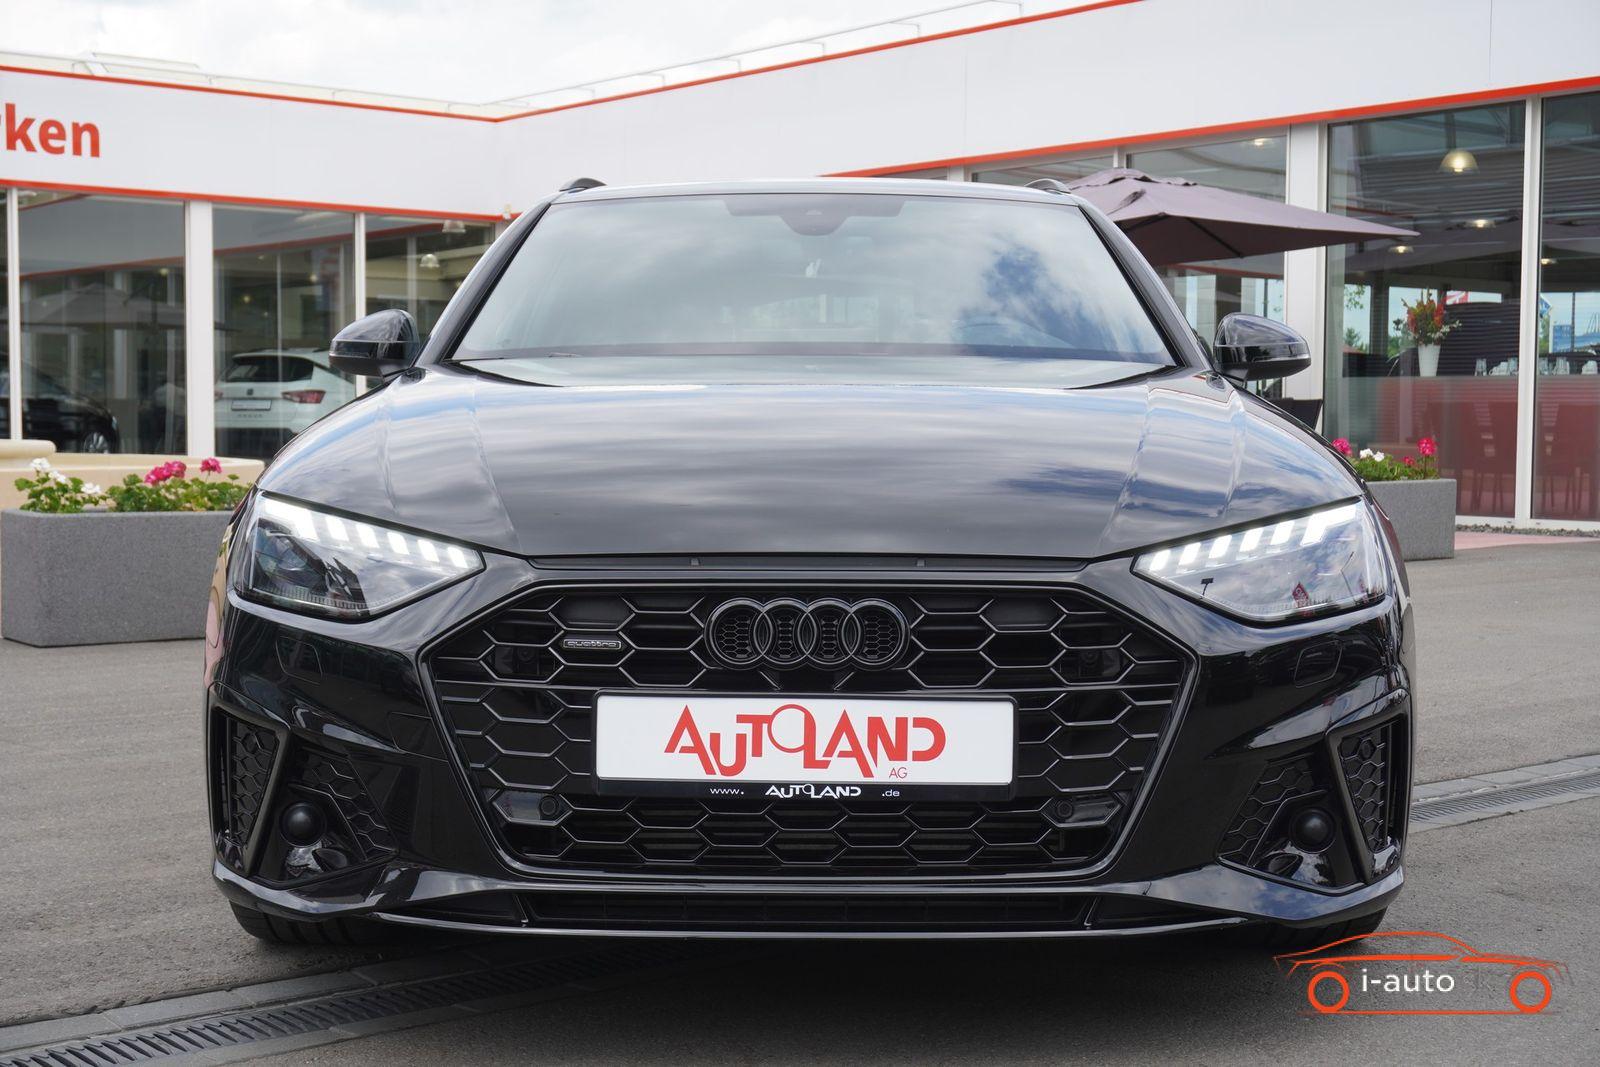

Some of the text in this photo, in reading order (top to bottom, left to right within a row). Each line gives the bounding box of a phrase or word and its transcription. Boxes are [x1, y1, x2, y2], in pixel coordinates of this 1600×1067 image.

[0, 102, 101, 158] ken
[566, 640, 618, 648] quattro
[888, 766, 909, 779] AG
